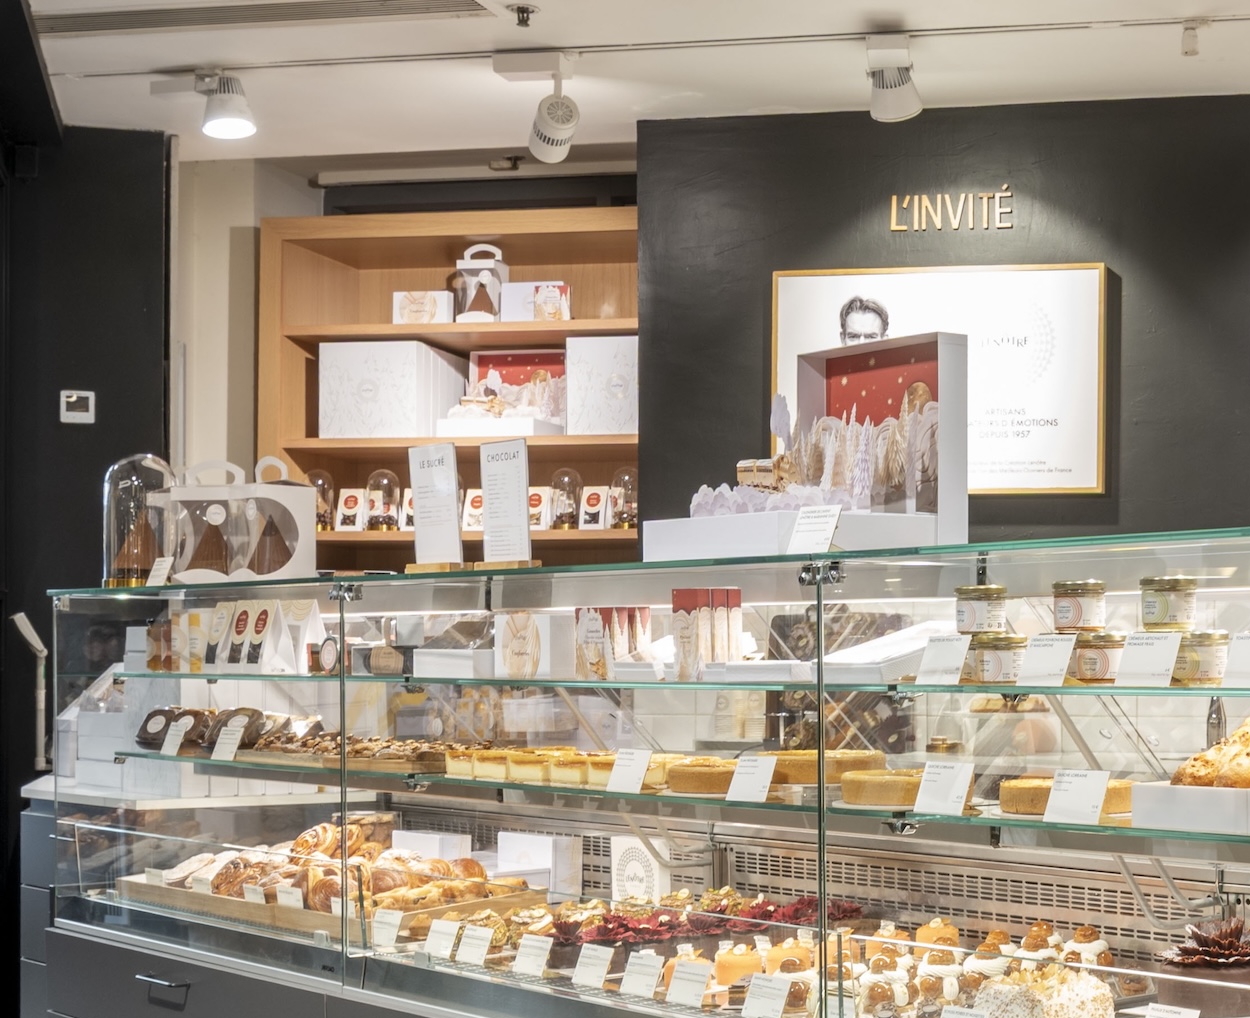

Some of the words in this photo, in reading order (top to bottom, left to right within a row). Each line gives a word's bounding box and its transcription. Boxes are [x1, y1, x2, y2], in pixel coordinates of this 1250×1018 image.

[890, 183, 1013, 231] L'INVITÉ
[1012, 430, 1031, 438] 1957
[419, 460, 426, 469] LE
[427, 456, 445, 468] SUCRÉ
[486, 451, 520, 463] CHOCOLAT
